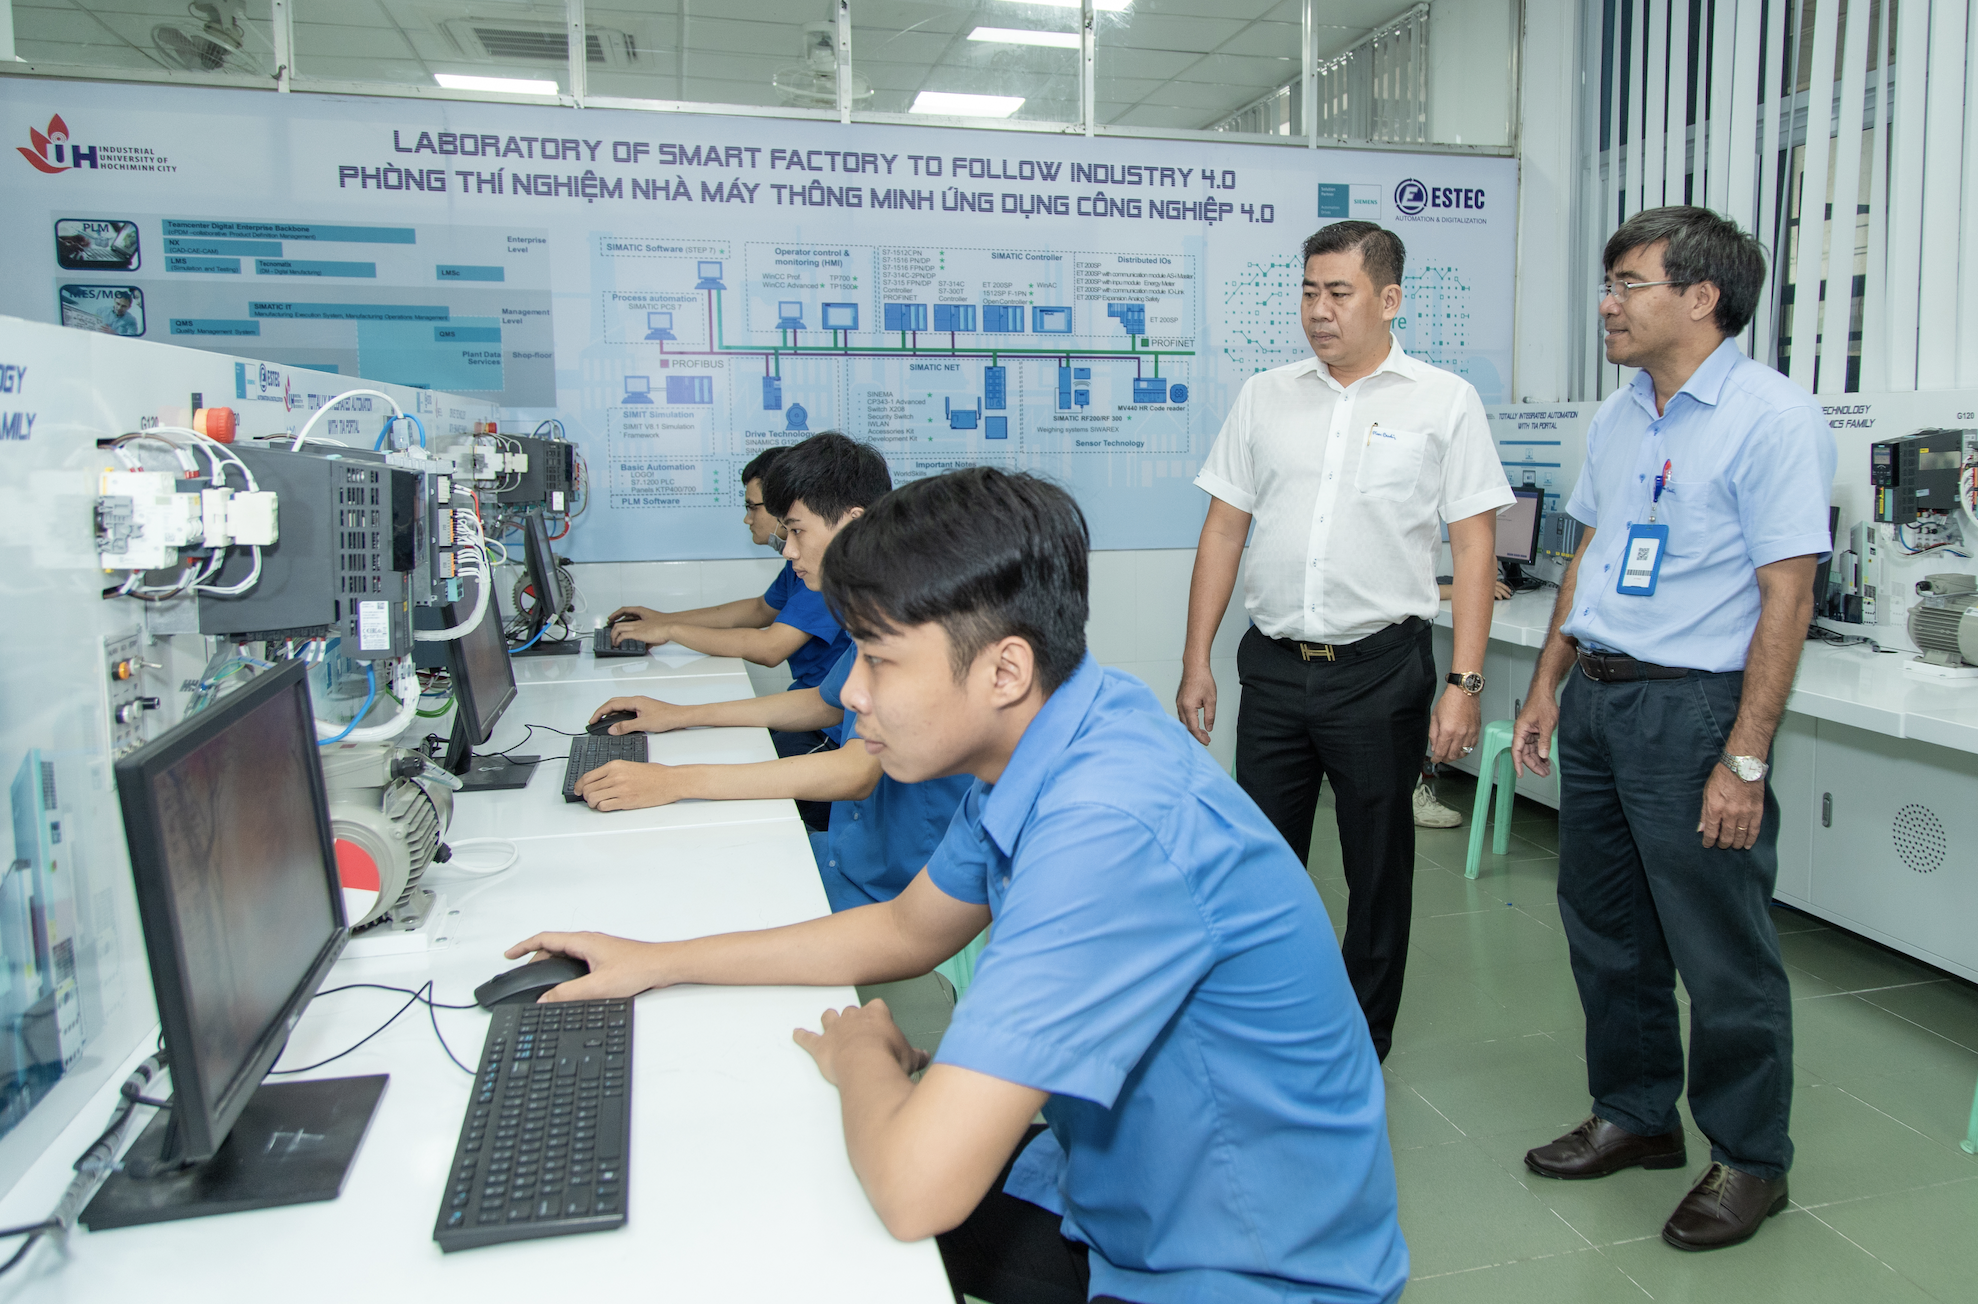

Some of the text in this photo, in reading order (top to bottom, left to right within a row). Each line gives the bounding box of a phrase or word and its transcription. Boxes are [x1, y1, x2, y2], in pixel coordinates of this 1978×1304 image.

[100, 146, 155, 155] INDUSTRIAL
[100, 154, 155, 163] UNIVERSITY
[393, 130, 1236, 190] LABORATORY OF SMART FACTORY TO FOLLOW INDUSTRY 4.0
[100, 163, 177, 173] HOCHIMINH CITY
[338, 162, 1275, 226] PHÒNG THÍ NGHIỆM NHÀ MÁY THÔNG MINH ỨNG DỤNG CÔNG NGHIỆP 4.0
[1431, 187, 1485, 210] ESTEC
[1395, 215, 1434, 223] AUTOMATION
[1441, 217, 1487, 225] DIGITALIZATION
[83, 223, 110, 233] PLM
[167, 221, 210, 229] Teamcenter
[212, 222, 234, 231] Digital
[236, 224, 273, 232] Enterprise
[507, 236, 547, 244] Enterprise
[606, 243, 716, 255] SIMATIC Software (STEP 7)
[775, 247, 812, 258] Operator
[813, 248, 842, 257] control
[991, 252, 1063, 262] SIMATIC Controller
[1118, 256, 1172, 265] Distributed IOs
[775, 258, 843, 269] monitoring (HMI)
[762, 273, 785, 281] WinCC
[786, 282, 819, 290] Advanced
[829, 283, 854, 291] TP1500
[612, 294, 698, 303] Process automation
[628, 303, 660, 311] SIMATIC
[661, 303, 676, 311] PCS
[502, 308, 550, 316] Management
[1151, 339, 1195, 347] PROFINET
[512, 352, 552, 360] Shop-floor
[672, 359, 725, 369] PROFIBUS
[909, 363, 942, 371] SIMATIC
[1821, 405, 1872, 415] ECHNOLOGY
[623, 411, 695, 419] SIMIT Simulation
[867, 413, 892, 421] Security
[1547, 411, 1579, 419] AUTOMATION
[1957, 412, 1975, 420] G120
[141, 415, 159, 431] G120
[1845, 418, 1876, 428] FAMILY
[745, 430, 816, 439] Drive Technology
[1037, 426, 1064, 434] Weighing
[868, 435, 907, 443] Development
[1103, 440, 1145, 448] Technology
[648, 463, 696, 471] Automation
[915, 461, 953, 470] Important
